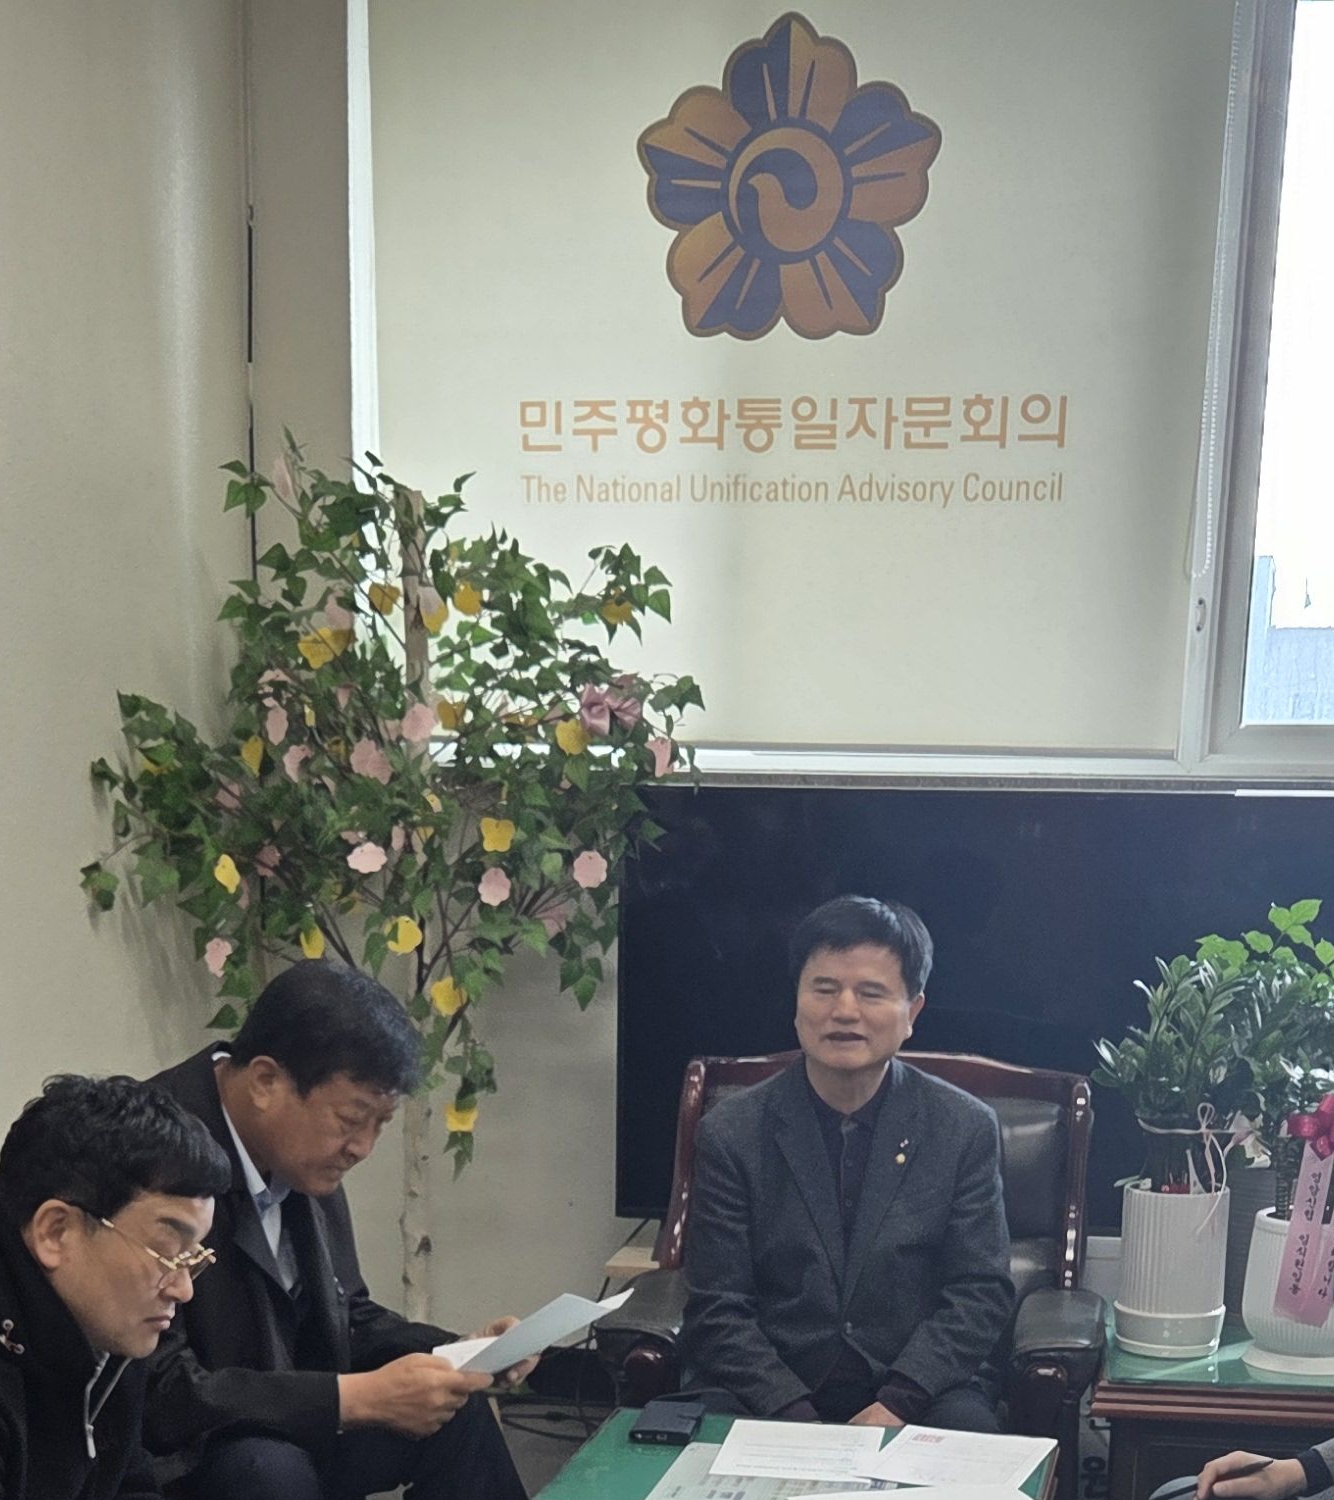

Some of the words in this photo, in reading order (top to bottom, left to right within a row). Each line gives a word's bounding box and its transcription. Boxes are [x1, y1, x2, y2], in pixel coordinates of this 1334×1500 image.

[520, 394, 1068, 454] 민주평화통일자문회의
[520, 474, 566, 503] The
[576, 473, 681, 503] National
[691, 472, 830, 503] Unification
[838, 472, 956, 509] Advisory
[962, 472, 1063, 502] Council
